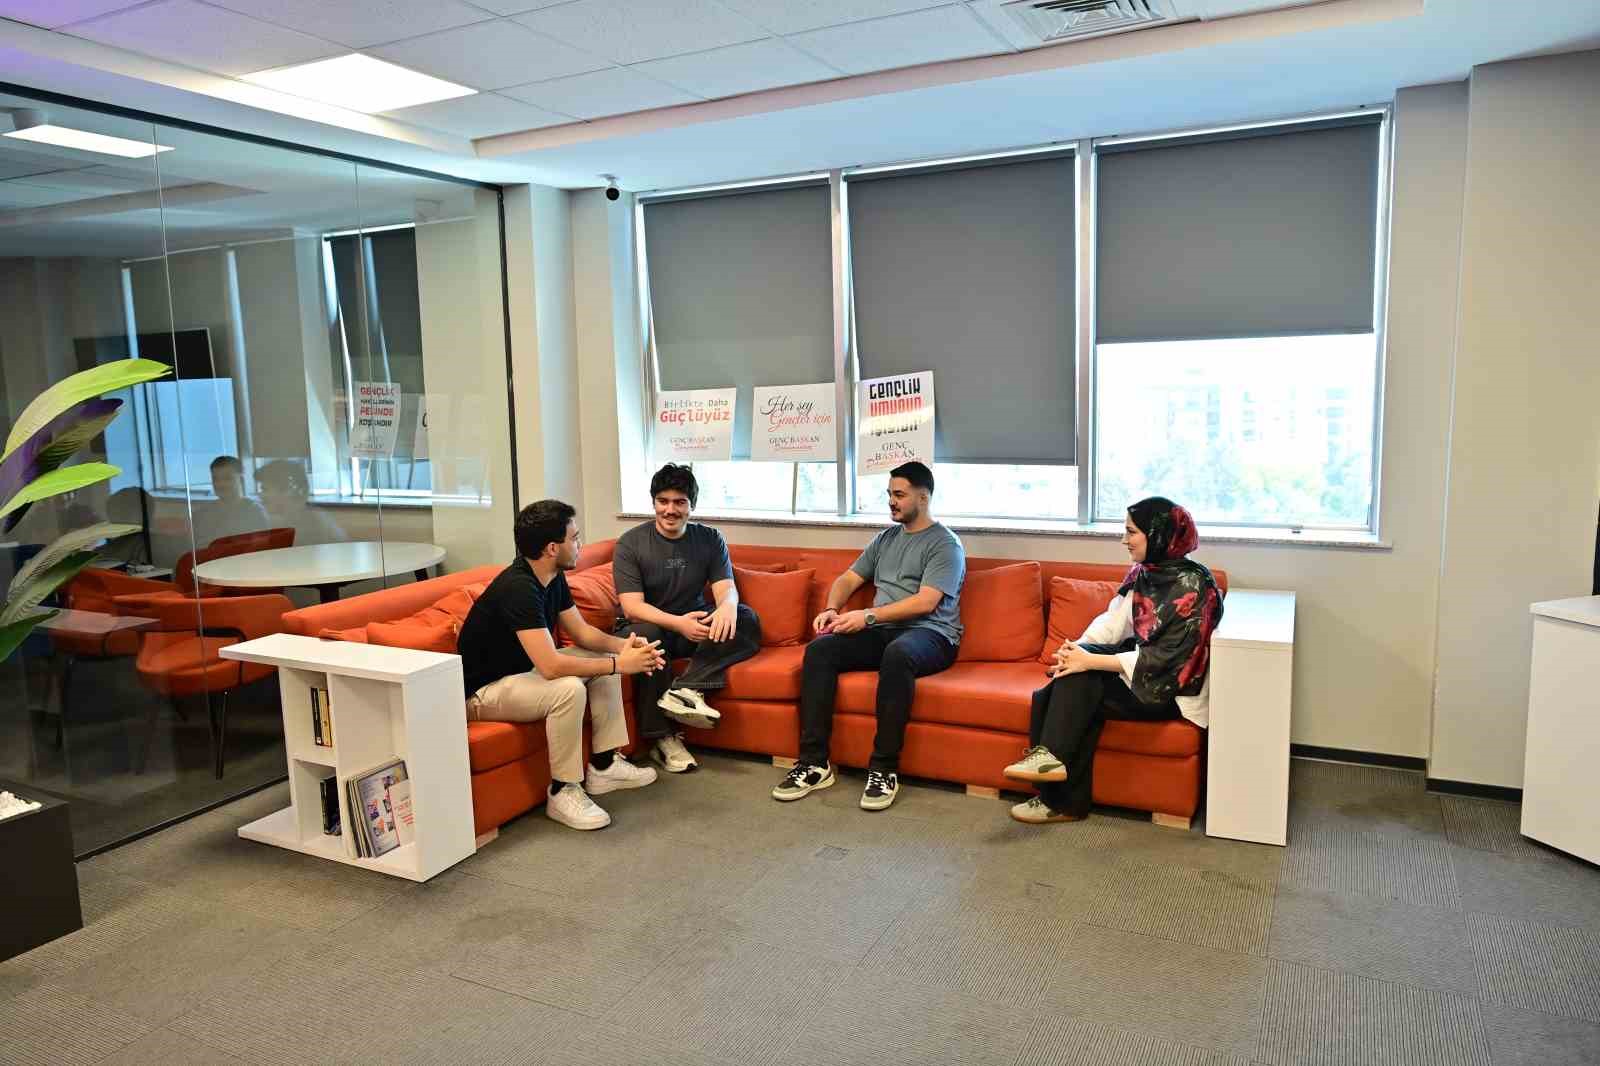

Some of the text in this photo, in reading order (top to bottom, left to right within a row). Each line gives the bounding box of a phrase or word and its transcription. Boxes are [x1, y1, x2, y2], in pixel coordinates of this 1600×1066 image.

[869, 376, 921, 400] GENÇLİK
[664, 398, 729, 409] Birlikte Daha
[760, 395, 794, 415] Her
[660, 408, 731, 426] Güçlüyüz
[882, 440, 910, 453] GENÇ
